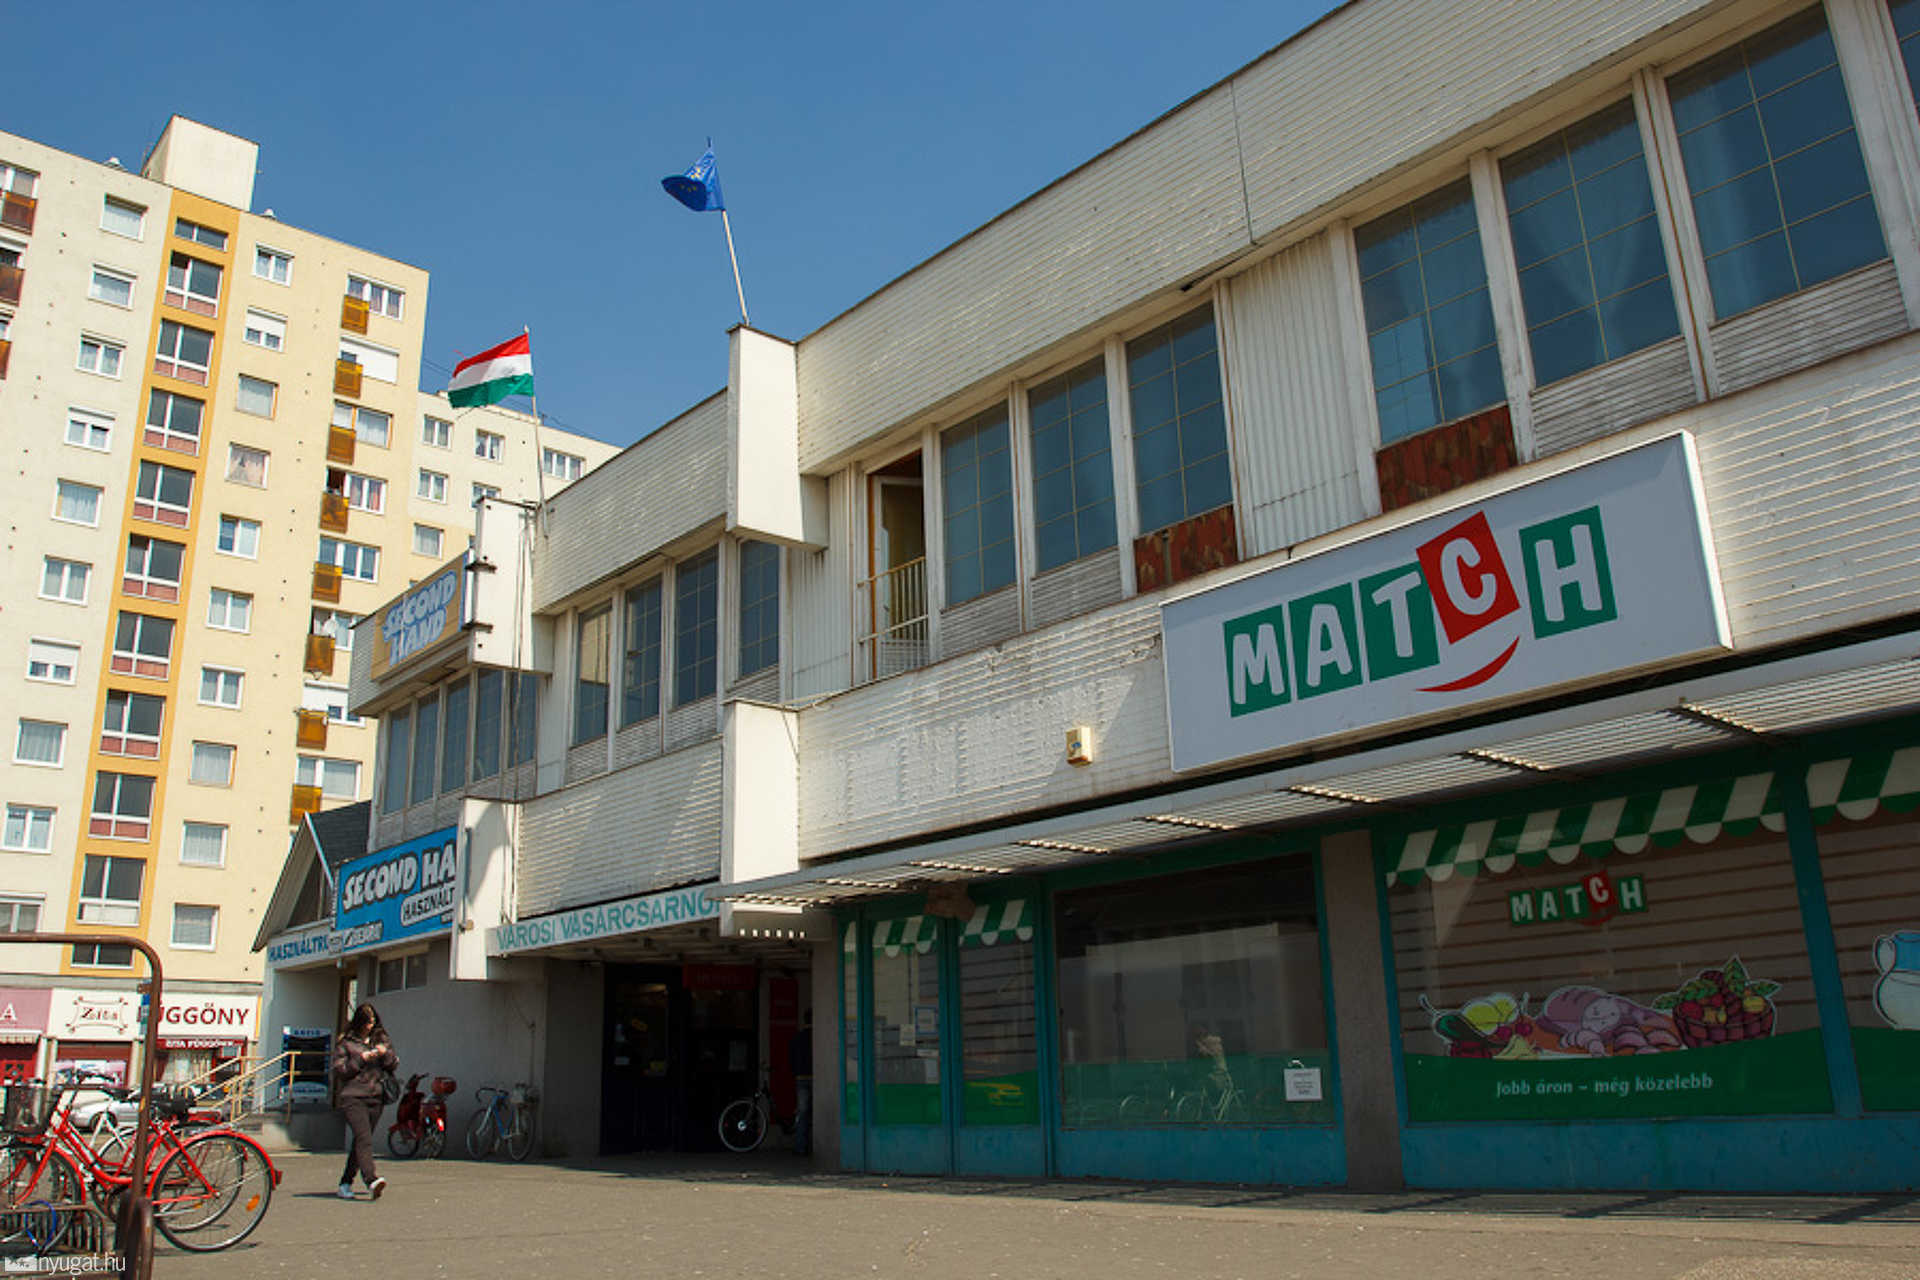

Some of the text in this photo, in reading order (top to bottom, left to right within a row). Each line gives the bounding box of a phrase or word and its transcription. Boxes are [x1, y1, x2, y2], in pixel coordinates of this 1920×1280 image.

[382, 570, 456, 642] SECOND
[1231, 522, 1604, 707] MATCH
[389, 606, 446, 666] HAND
[342, 855, 417, 912] SECOND
[1511, 876, 1643, 922] MATCH
[1496, 1079, 1531, 1098] Jobb
[1535, 1078, 1573, 1094] áron
[1594, 1076, 1630, 1096] még
[1635, 1072, 1713, 1092] közelebb
